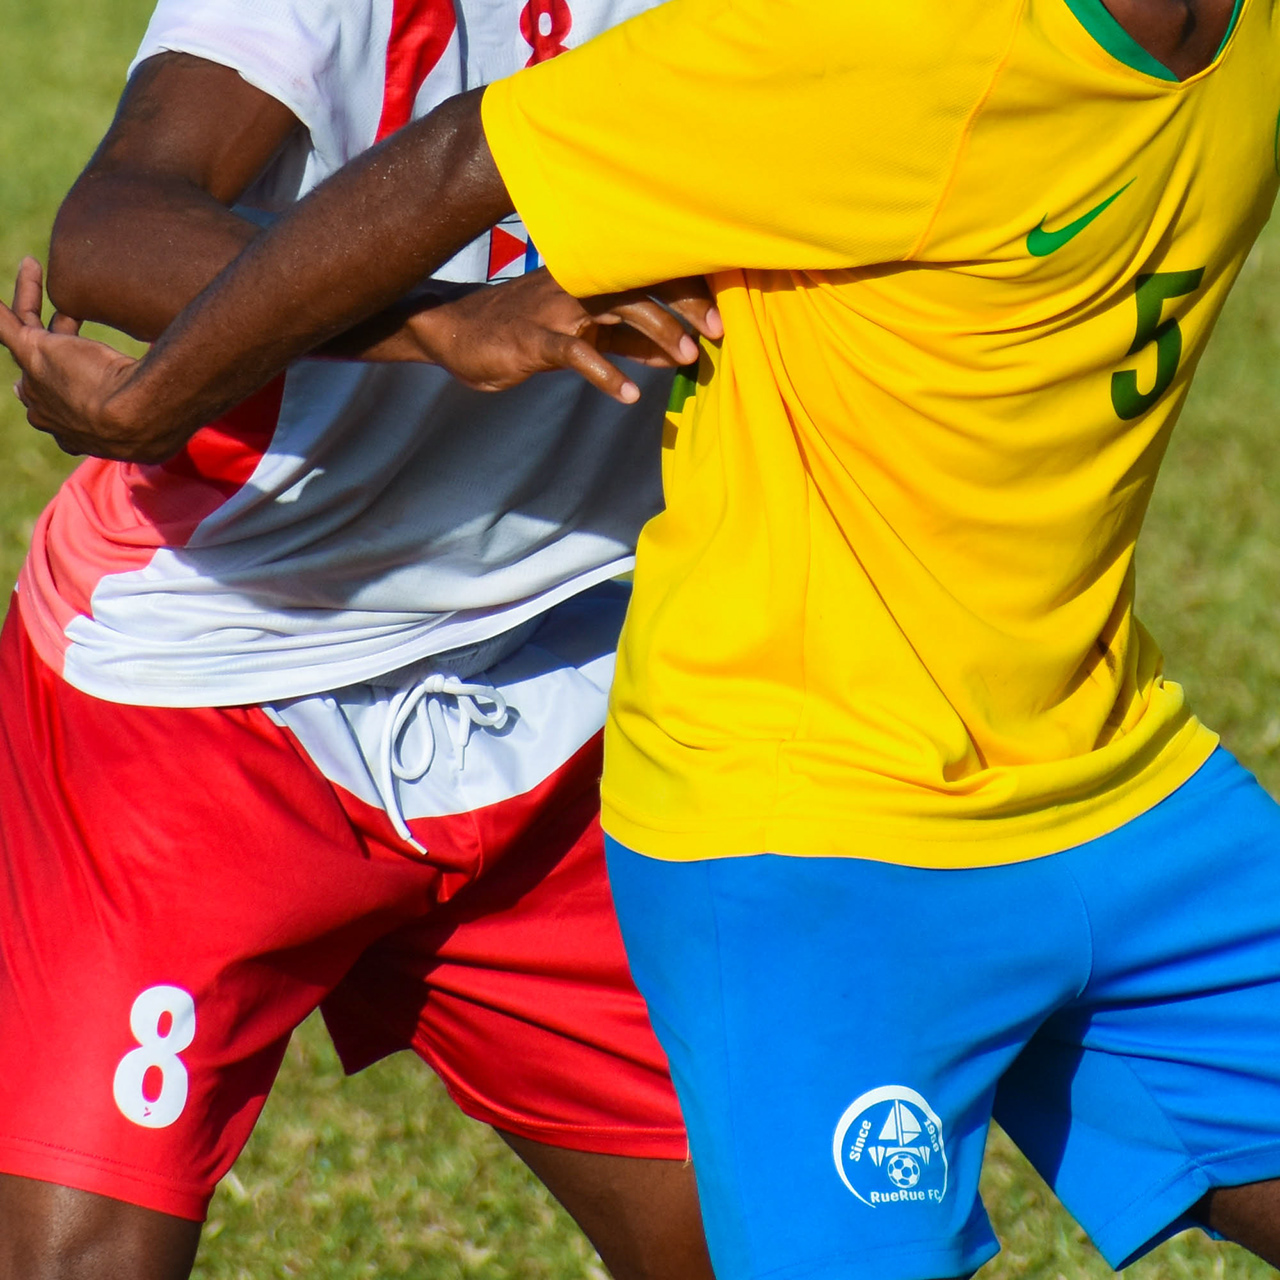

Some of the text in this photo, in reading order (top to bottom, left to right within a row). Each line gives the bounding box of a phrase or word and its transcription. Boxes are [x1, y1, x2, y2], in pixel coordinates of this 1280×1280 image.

[1111, 266, 1206, 421] 5
[113, 985, 196, 1129] 8
[849, 1120, 872, 1162] Since
[870, 1188, 941, 1203] RueRue FC
